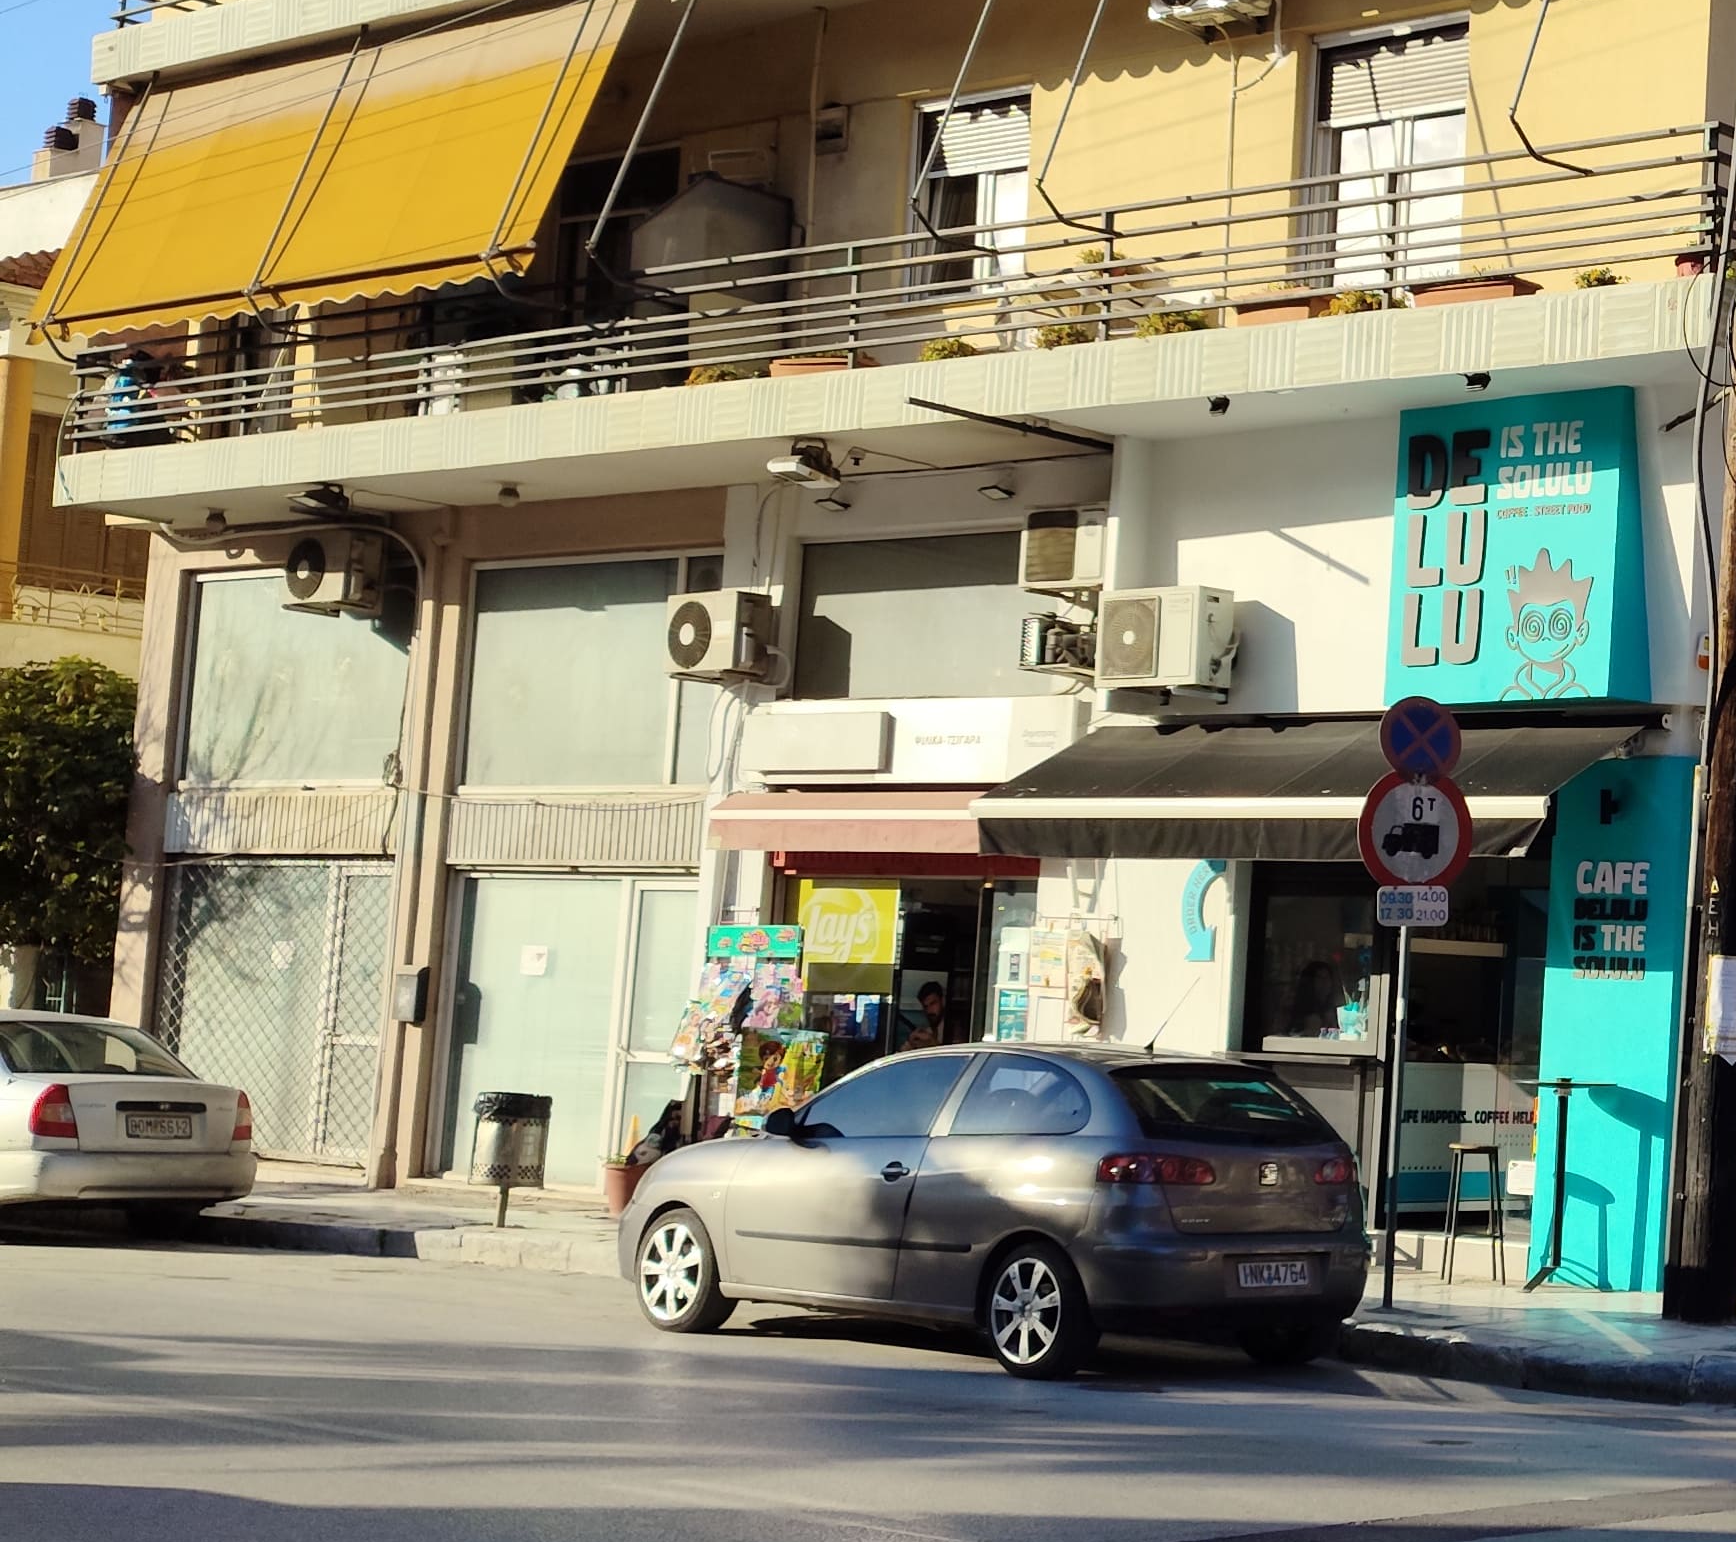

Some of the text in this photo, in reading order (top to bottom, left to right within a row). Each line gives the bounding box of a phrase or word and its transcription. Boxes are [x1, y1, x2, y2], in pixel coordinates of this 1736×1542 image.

[1500, 420, 1584, 458] IS THE
[1407, 429, 1490, 510] DE
[1496, 460, 1593, 500] SOLULU
[1407, 509, 1488, 589] LU
[1401, 589, 1484, 667] LU
[1576, 860, 1650, 895] CAFE
[1417, 891, 1447, 903] 14.00
[1573, 898, 1648, 922] DELULU
[1416, 909, 1447, 922] 21.00
[1573, 924, 1646, 952] IS THE
[1572, 955, 1646, 981] SOLULU
[1474, 1110, 1510, 1125] COFFEE
